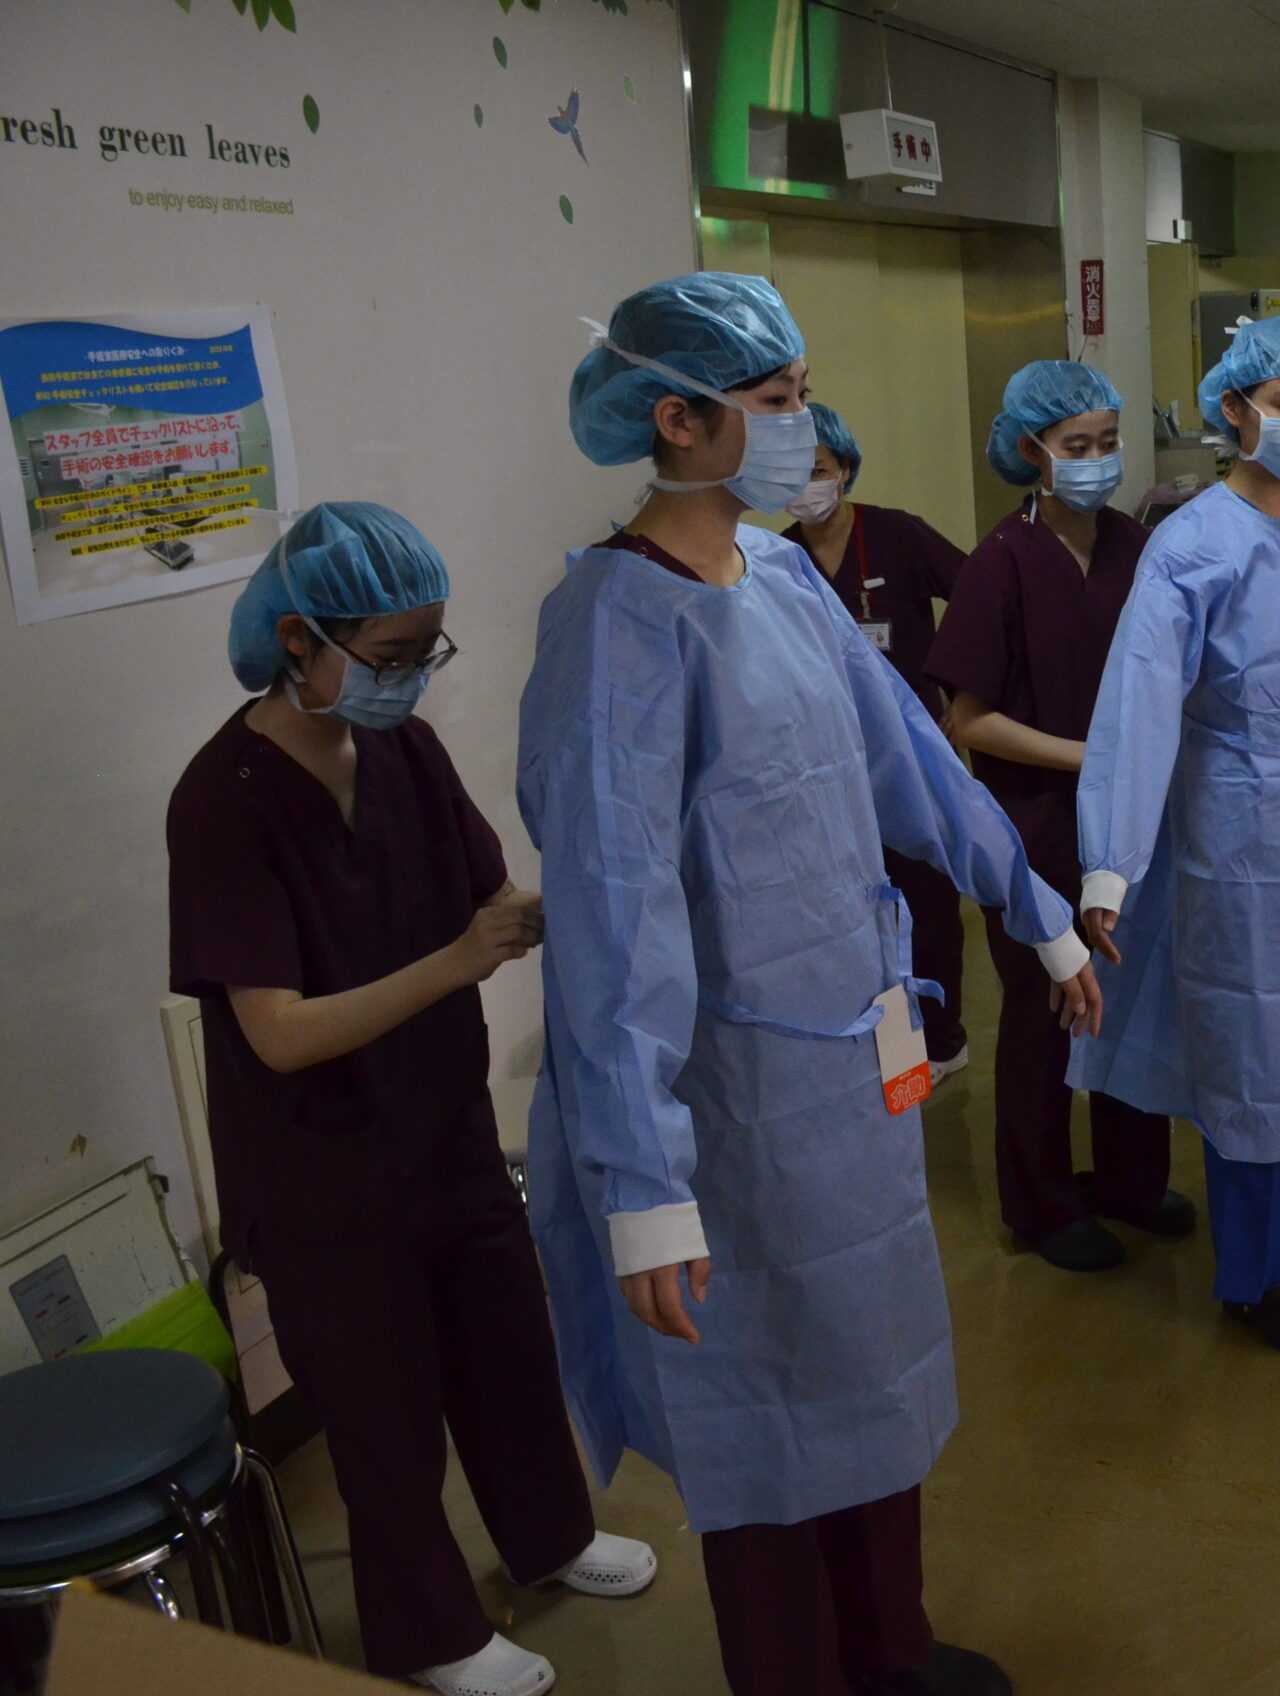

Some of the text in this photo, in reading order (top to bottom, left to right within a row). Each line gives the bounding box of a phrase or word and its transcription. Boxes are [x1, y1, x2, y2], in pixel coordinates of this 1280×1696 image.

[99, 125, 188, 162] green
[205, 124, 291, 169] leaves
[892, 131, 931, 163] 手術中
[128, 188, 294, 214] to enjoy easy and relaxed
[1085, 265, 1101, 316] 消火器
[45, 413, 241, 452] スタッフ全員でチェックリストに沿って、
[60, 440, 236, 477] 手術の安全確認をお願いします。
[890, 1073, 926, 1110] 介助
